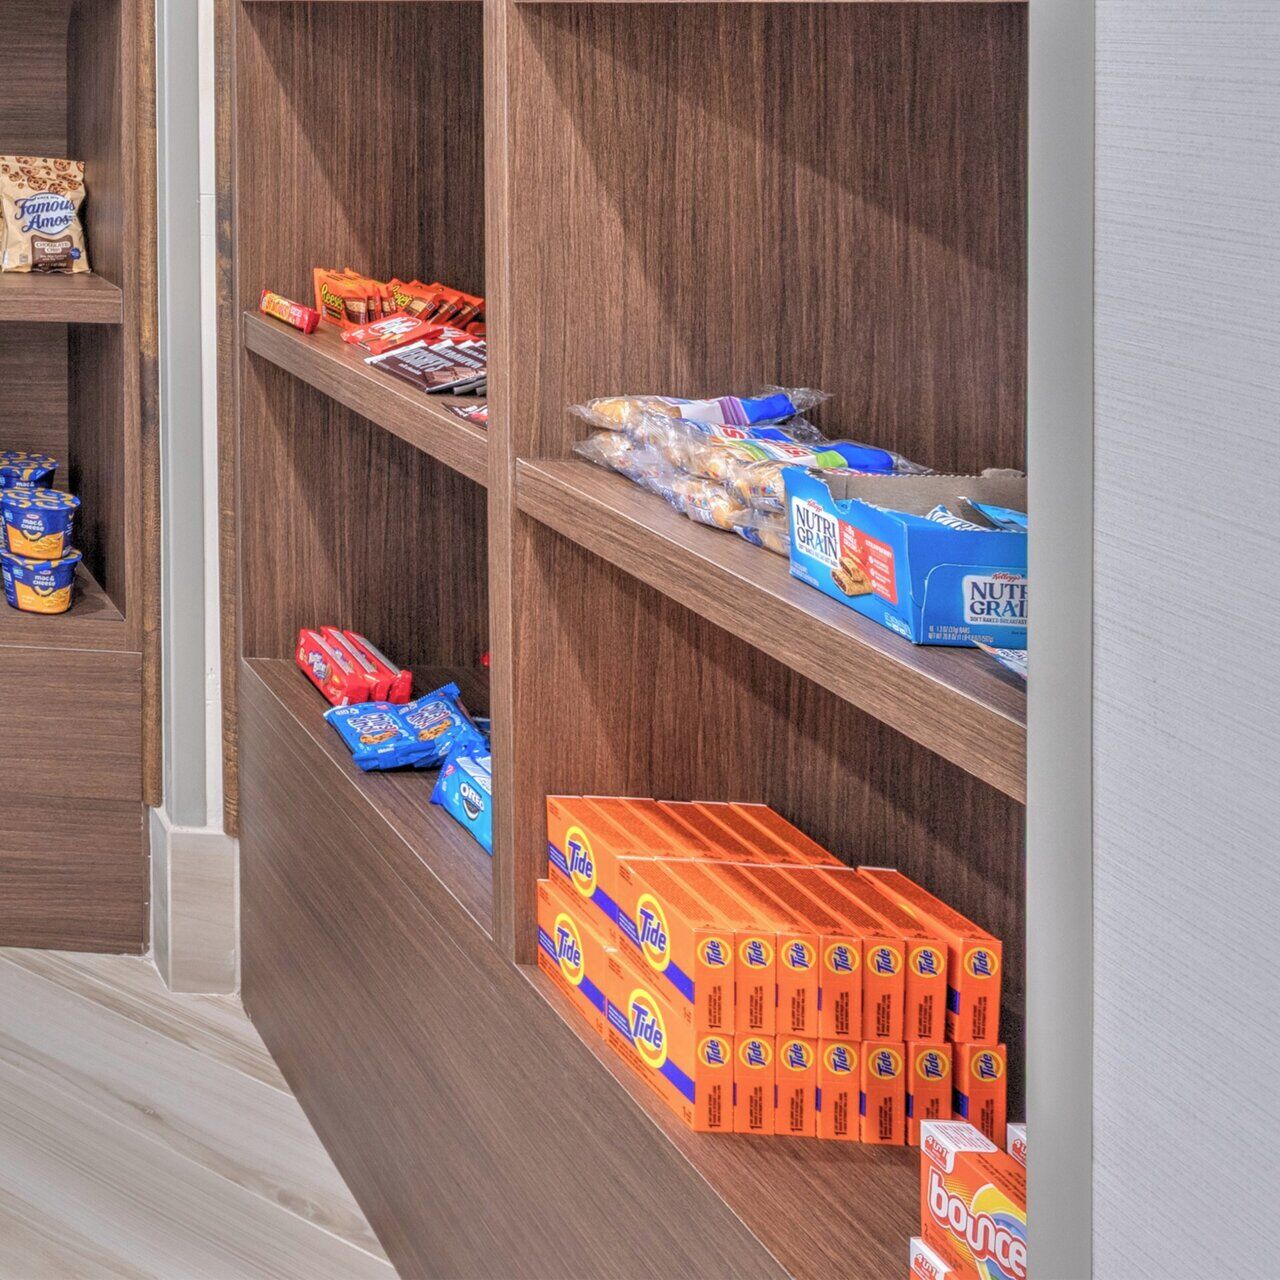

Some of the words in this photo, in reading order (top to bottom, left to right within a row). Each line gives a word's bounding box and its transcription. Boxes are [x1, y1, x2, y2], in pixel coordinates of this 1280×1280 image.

[14, 197, 76, 222] Famous
[21, 212, 70, 233] Amos
[795, 504, 836, 539] NUTRI
[796, 526, 839, 561] GRAIN
[567, 839, 594, 880] Tide
[555, 925, 582, 969] Tide
[638, 907, 668, 954] Tide
[705, 940, 725, 966] Tide
[748, 940, 767, 967] Tide
[630, 1001, 664, 1050] Tide
[929, 1171, 1026, 1279] bounce
